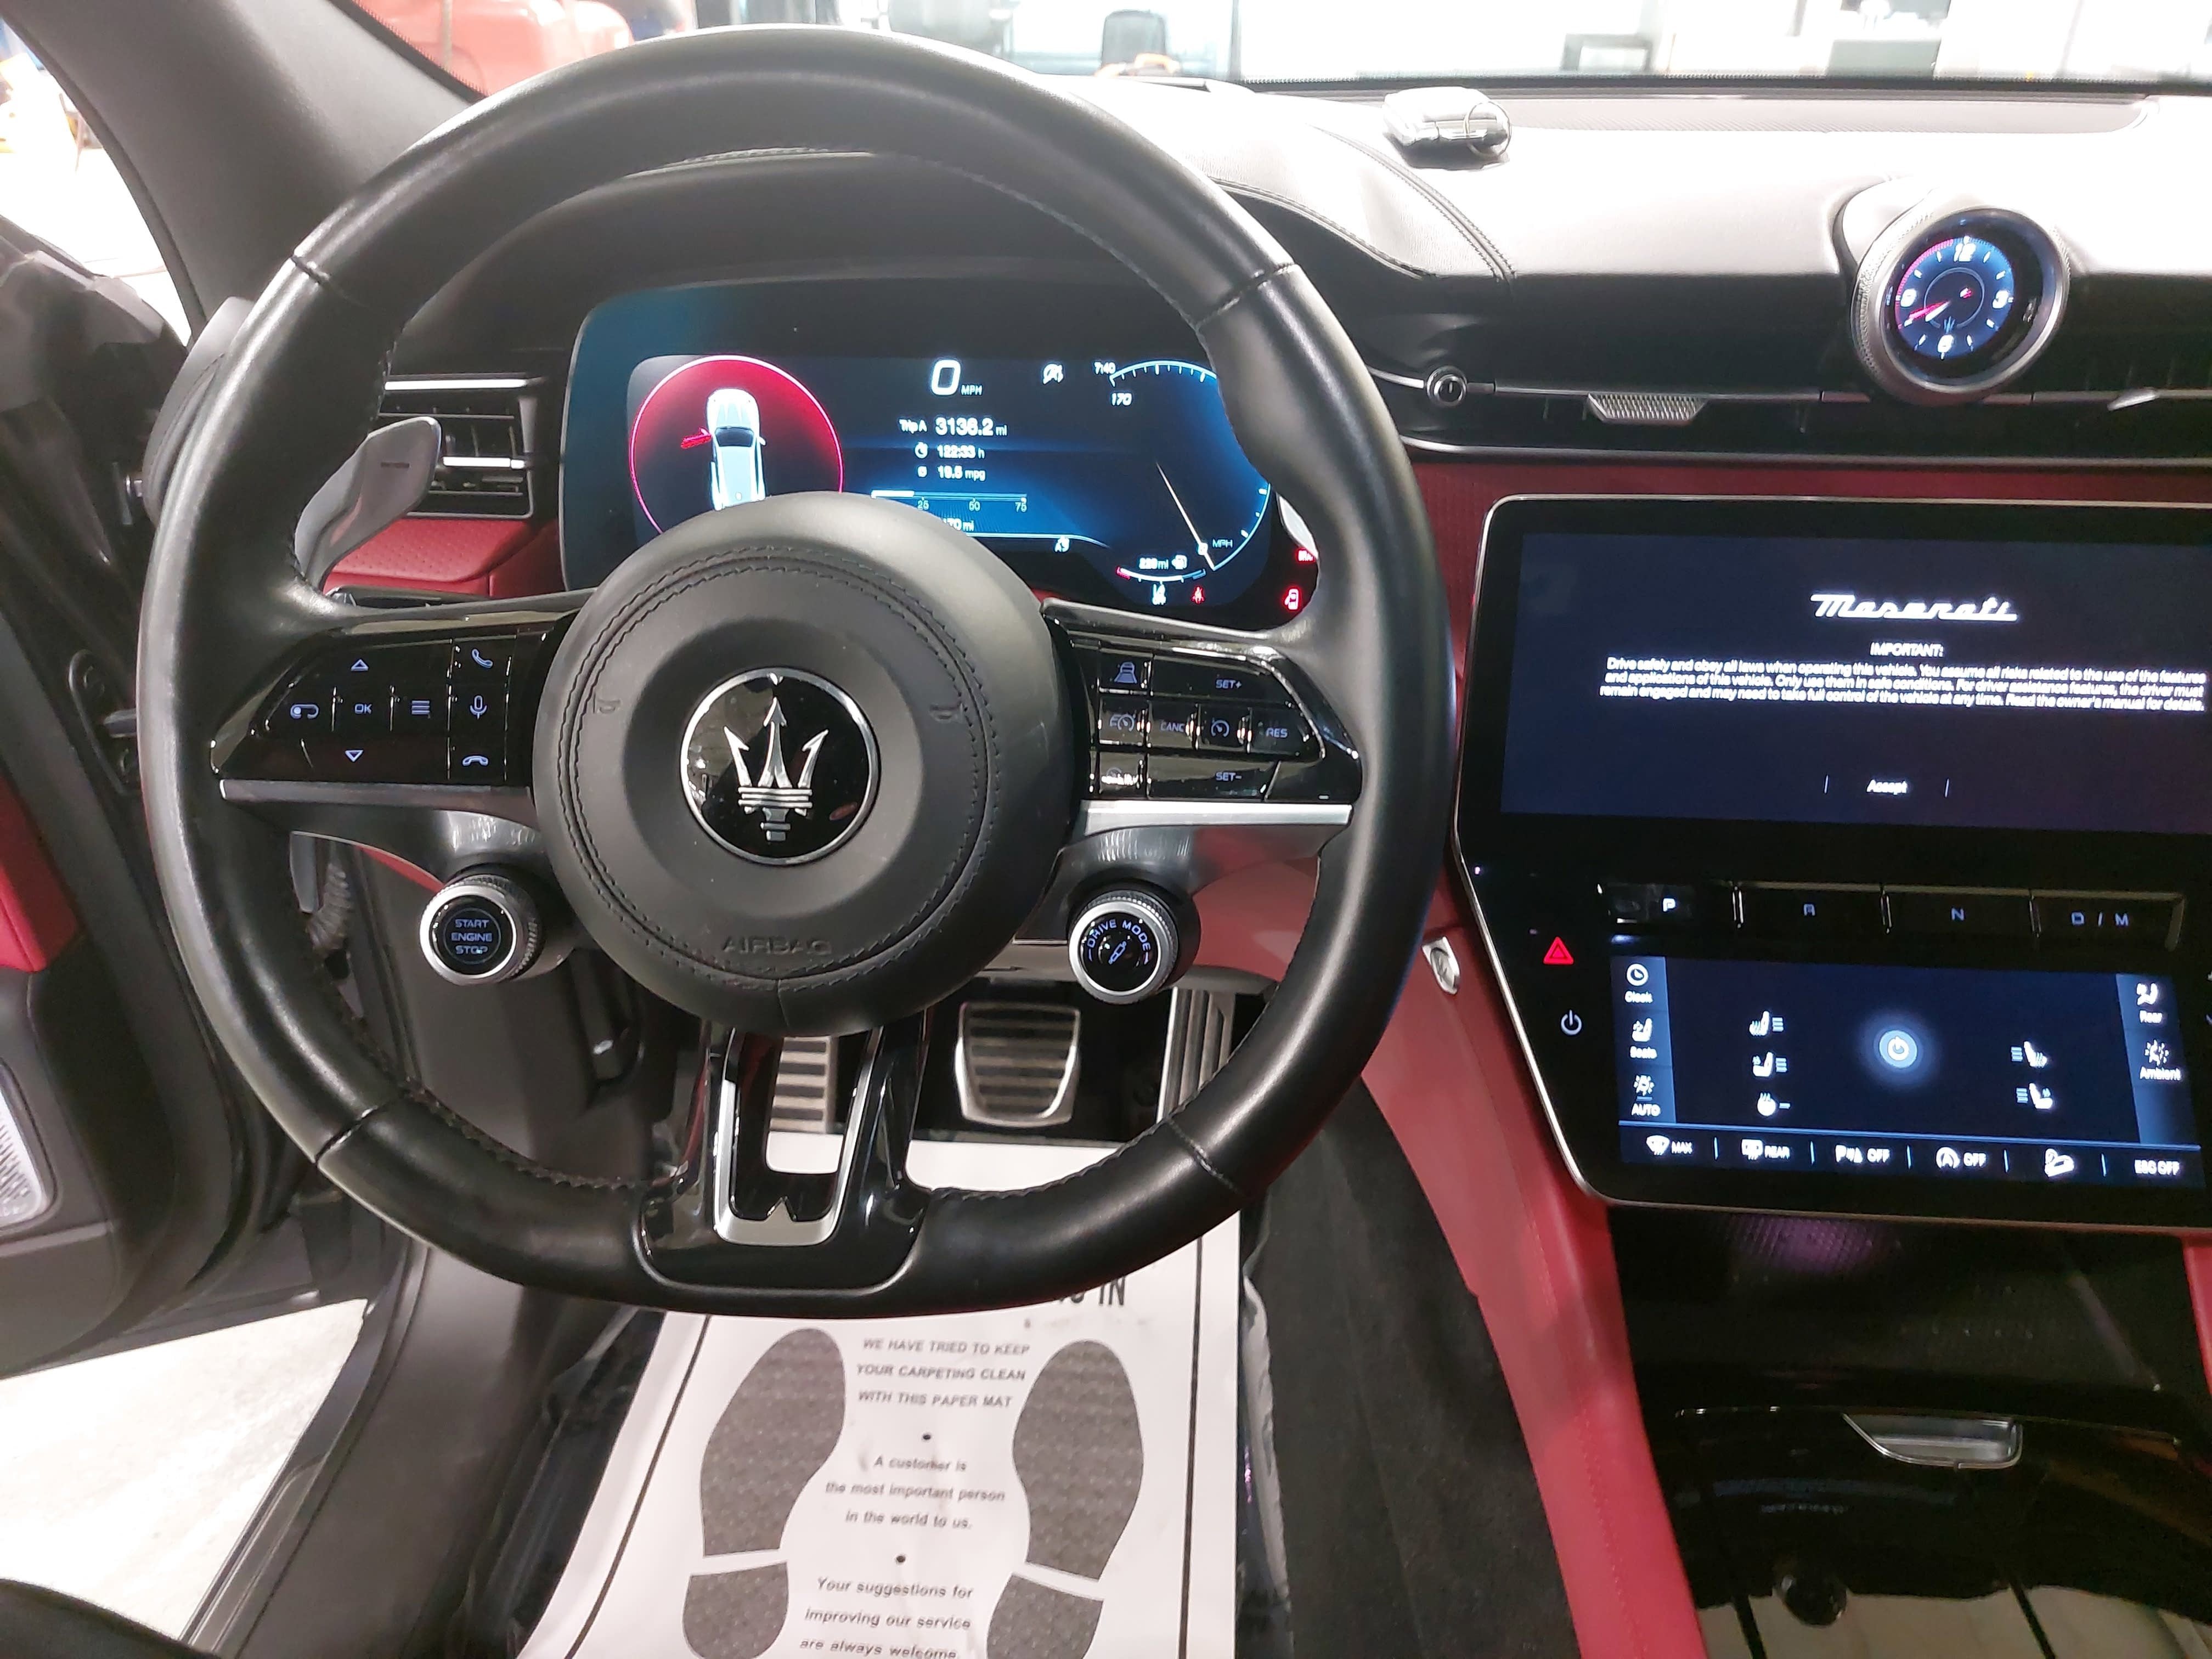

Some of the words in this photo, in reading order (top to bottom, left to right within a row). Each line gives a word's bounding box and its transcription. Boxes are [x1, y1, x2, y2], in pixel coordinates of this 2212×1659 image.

[931, 359, 961, 395] 0
[961, 385, 983, 395] MPH
[1112, 393, 1132, 405] 170
[995, 425, 1007, 436] mi
[978, 448, 985, 459] h
[965, 469, 985, 481] mpg
[1212, 539, 1233, 548] MPH
[1810, 595, 2017, 620] Maserati
[1870, 642, 1944, 657] IMPORTANT:
[1607, 657, 1637, 670] Drive
[1637, 658, 1670, 673] safely
[1671, 659, 1694, 672] and
[1694, 659, 1723, 674] obey
[1724, 659, 1737, 672] all
[1739, 660, 1764, 673] laws
[1766, 661, 1797, 674] when
[1798, 662, 1852, 678] operating
[1853, 662, 1874, 675] this
[1920, 663, 1940, 677] You
[1941, 666, 1985, 678] assume
[1986, 665, 2000, 678] all
[2001, 667, 2028, 680] risks
[2029, 667, 2069, 681] related
[2069, 669, 2083, 681] to
[2083, 668, 2102, 681] the
[2103, 670, 2125, 682] use
[2125, 669, 2139, 682] of
[2140, 669, 2159, 682] the
[2159, 670, 2207, 684] features
[1605, 672, 1628, 683] and
[1628, 672, 1695, 686] applications
[1696, 673, 1709, 685] of
[1710, 673, 1730, 685] this
[1775, 674, 1803, 689] Only
[1803, 677, 1825, 688] use
[1825, 676, 1855, 689] them
[1855, 676, 1866, 689] in
[1867, 677, 1893, 690] safe
[1956, 679, 1975, 691] For
[1976, 679, 2009, 692] driver
[2009, 681, 2068, 694] assistance
[2119, 683, 2139, 696] the
[2140, 684, 2174, 697] driver
[2174, 685, 2204, 697] must
[1600, 685, 1638, 697] remain
[1639, 686, 1688, 700] engaged
[1688, 686, 1711, 698] and
[1712, 688, 1737, 701] may
[1738, 688, 1767, 699] need
[1768, 689, 1780, 700] to
[1781, 689, 1806, 701] take
[1807, 689, 1825, 701] full
[1826, 690, 1865, 702] control
[1866, 690, 1879, 703] of
[1880, 690, 1899, 703] the
[1900, 691, 1939, 704] vehicle
[1940, 692, 1952, 704] at
[1953, 694, 1974, 708] any
[2005, 693, 2036, 707] Read
[2036, 694, 2056, 707] the
[2057, 696, 2101, 709] owner's
[2102, 696, 2145, 710] manual
[2146, 697, 2163, 710] for
[355, 703, 371, 714] OK
[1266, 727, 1288, 738] RES
[1866, 780, 1907, 795] Accept
[1663, 898, 1675, 912] P
[1951, 908, 1964, 921] N
[2071, 912, 2084, 926] D
[2115, 912, 2129, 926] M
[455, 919, 489, 928] START
[452, 933, 492, 942] ENGINE
[1087, 919, 1116, 948] DRIVE
[1122, 920, 1151, 951] MODE
[455, 945, 488, 954] STOP
[723, 935, 832, 955] AIRBAG
[1625, 991, 1653, 1003] Clock
[2140, 1067, 2181, 1080] Ambient
[1632, 1103, 1661, 1116] AUTO
[1671, 1141, 1693, 1154] MAX
[1764, 1146, 1790, 1159] REAR
[1867, 1148, 1889, 1162] OFF
[1964, 1153, 1987, 1166] OFF
[2158, 1161, 2180, 1175] OFF
[1099, 1276, 1125, 1305] IN
[864, 1339, 883, 1349] WE
[888, 1339, 924, 1352] HAVE
[930, 1341, 967, 1353] TRIED
[973, 1342, 990, 1355] TO
[995, 1344, 1030, 1355] KEEP
[857, 1364, 894, 1376] YOUR
[899, 1365, 975, 1379] CARPETING
[980, 1368, 1026, 1380] CLEAN
[859, 1391, 892, 1403] WITH
[899, 1392, 927, 1404] THIS
[933, 1393, 979, 1406] PAPER
[983, 1396, 1012, 1407] MAT
[873, 1456, 883, 1466] A
[889, 1457, 950, 1471] customer
[956, 1460, 967, 1471] is
[825, 1481, 846, 1494] the
[851, 1484, 884, 1496] most
[889, 1484, 953, 1499] important
[958, 1488, 1006, 1503] person
[845, 1510, 858, 1522] in
[864, 1511, 885, 1524] the
[890, 1513, 928, 1527] world
[933, 1515, 947, 1528] to
[952, 1519, 972, 1529] us.
[817, 1576, 851, 1592] Your
[856, 1581, 946, 1598] suggestions
[952, 1585, 973, 1599] for
[804, 1607, 880, 1628] improving
[885, 1616, 911, 1627] our
[916, 1616, 970, 1630] service
[799, 1639, 824, 1650] are
[830, 1640, 882, 1657] always
